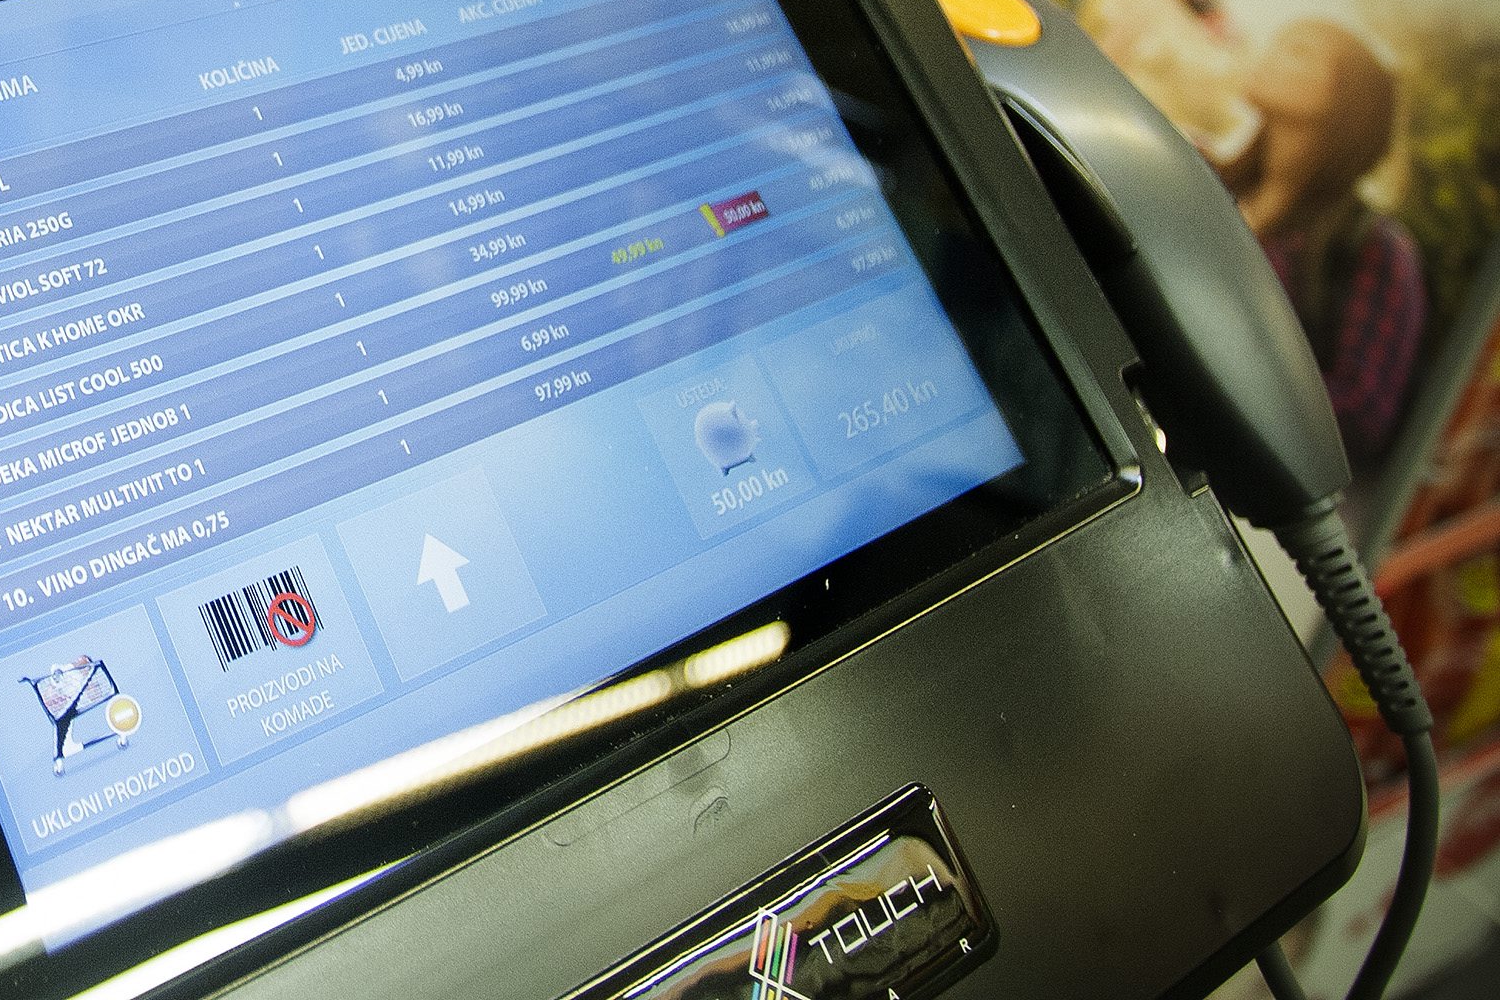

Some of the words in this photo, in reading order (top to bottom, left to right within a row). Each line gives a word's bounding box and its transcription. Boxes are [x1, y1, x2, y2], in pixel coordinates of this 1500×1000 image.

[340, 32, 373, 55] JED.
[373, 18, 428, 45] CIJENA
[199, 56, 280, 90] KOLIČINA
[395, 64, 425, 83] 4,99
[424, 58, 443, 74] kn
[253, 106, 263, 121] 1
[407, 105, 445, 128] 16,99
[444, 101, 464, 118] kn
[273, 151, 283, 167] 1
[428, 148, 465, 173] 11,99
[464, 144, 484, 161] kn
[293, 198, 303, 213] 1
[448, 191, 488, 216] 14,99
[487, 187, 506, 204] kn
[26, 211, 74, 240] 250G
[314, 244, 324, 260] 1
[469, 237, 508, 263] 34,99
[506, 233, 526, 250] kn
[38, 267, 83, 292] SOFT
[83, 257, 108, 279] 72
[335, 292, 346, 308] 1
[491, 283, 529, 308] 99,99
[527, 277, 548, 295] kn
[36, 331, 53, 350] K
[52, 314, 107, 346] HOME
[107, 302, 145, 328] OKR
[521, 328, 550, 352] 6,99
[548, 323, 570, 340] kn
[356, 340, 367, 356] 1
[39, 385, 77, 410] LIST
[78, 365, 131, 396] COOL
[130, 354, 164, 381] 500
[534, 376, 573, 402] 97,99
[571, 370, 592, 388] kn
[377, 389, 389, 406] 1
[837, 387, 910, 440] 265,40
[907, 377, 938, 408] kn
[37, 435, 110, 472] MICROF
[109, 410, 180, 448] JEDNOB
[180, 403, 192, 421] 1
[400, 439, 412, 455] 1
[5, 505, 81, 546] NEKTAR
[81, 472, 164, 515] MULTIVIT
[164, 463, 193, 486] TO
[194, 458, 206, 475] 1
[710, 475, 765, 517] 50,00
[764, 466, 790, 492] kn
[3, 587, 34, 612] 10.
[36, 565, 88, 599] VINO
[89, 534, 162, 580] DINGAČ
[161, 525, 192, 552] MA
[191, 510, 230, 540] 0,75
[226, 667, 318, 719] PROIZVODI
[315, 653, 345, 680] NA
[260, 690, 336, 737] KOMADE
[31, 792, 104, 840] UKLONI
[102, 751, 196, 811] PROIZVOD
[808, 863, 943, 964] TOUCH
[959, 937, 973, 954] R
